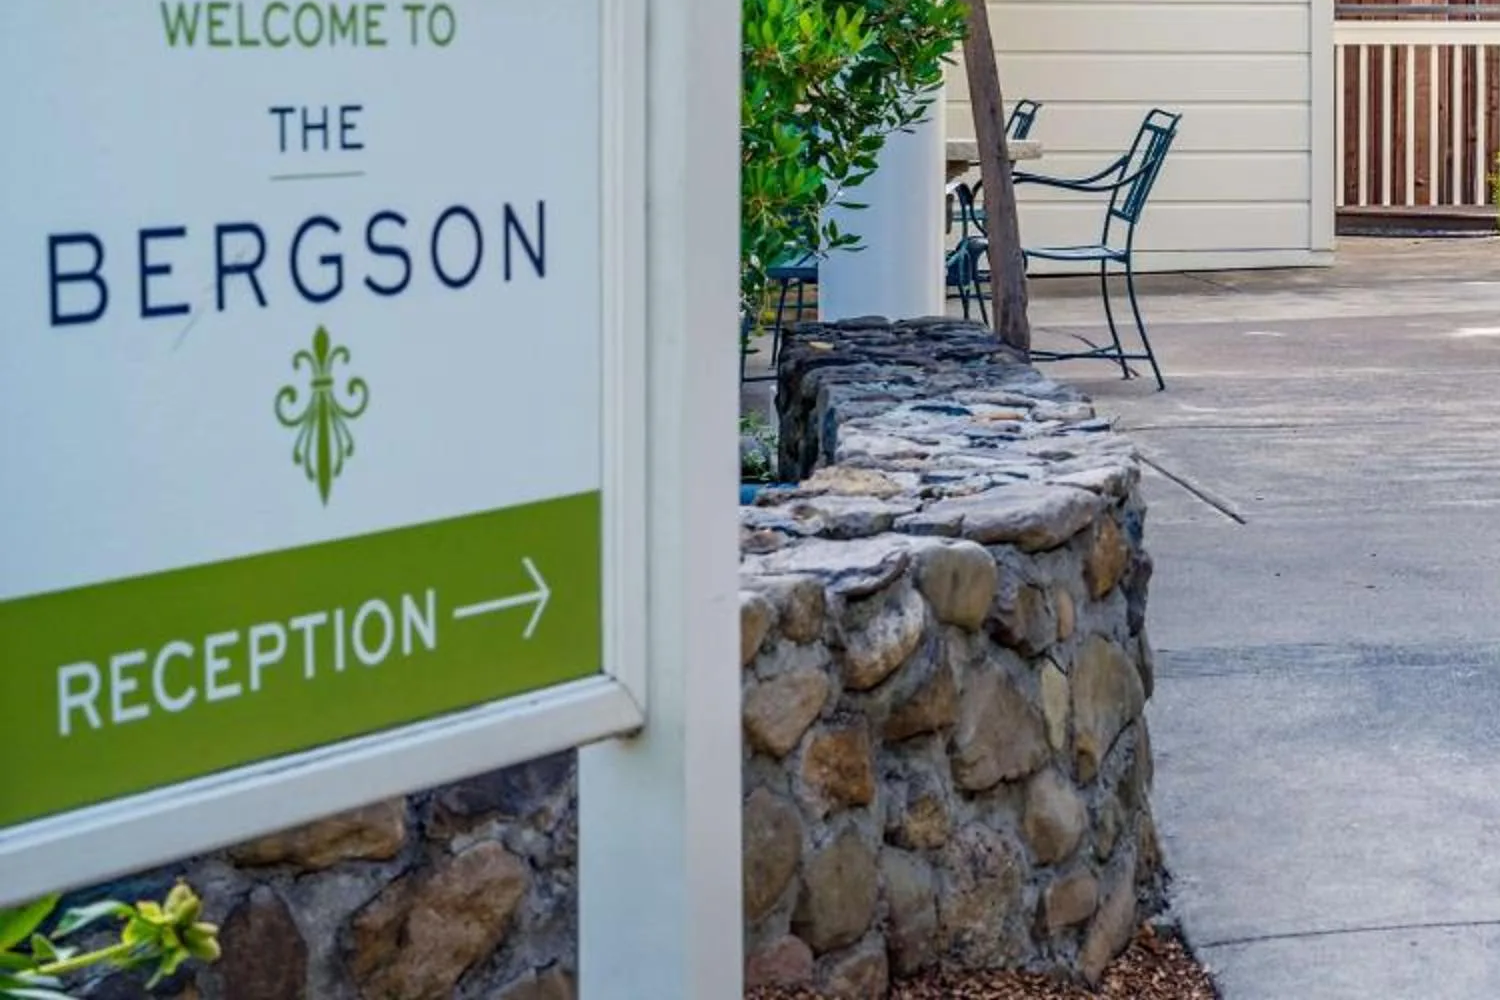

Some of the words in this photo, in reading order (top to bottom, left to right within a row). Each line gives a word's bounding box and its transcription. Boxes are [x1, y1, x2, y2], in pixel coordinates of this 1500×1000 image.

[160, 0, 389, 49] WELCOME
[402, 2, 456, 48] TO
[268, 104, 365, 153] THE
[47, 199, 548, 328] BERGSON
[56, 587, 438, 738] RECEPTION
